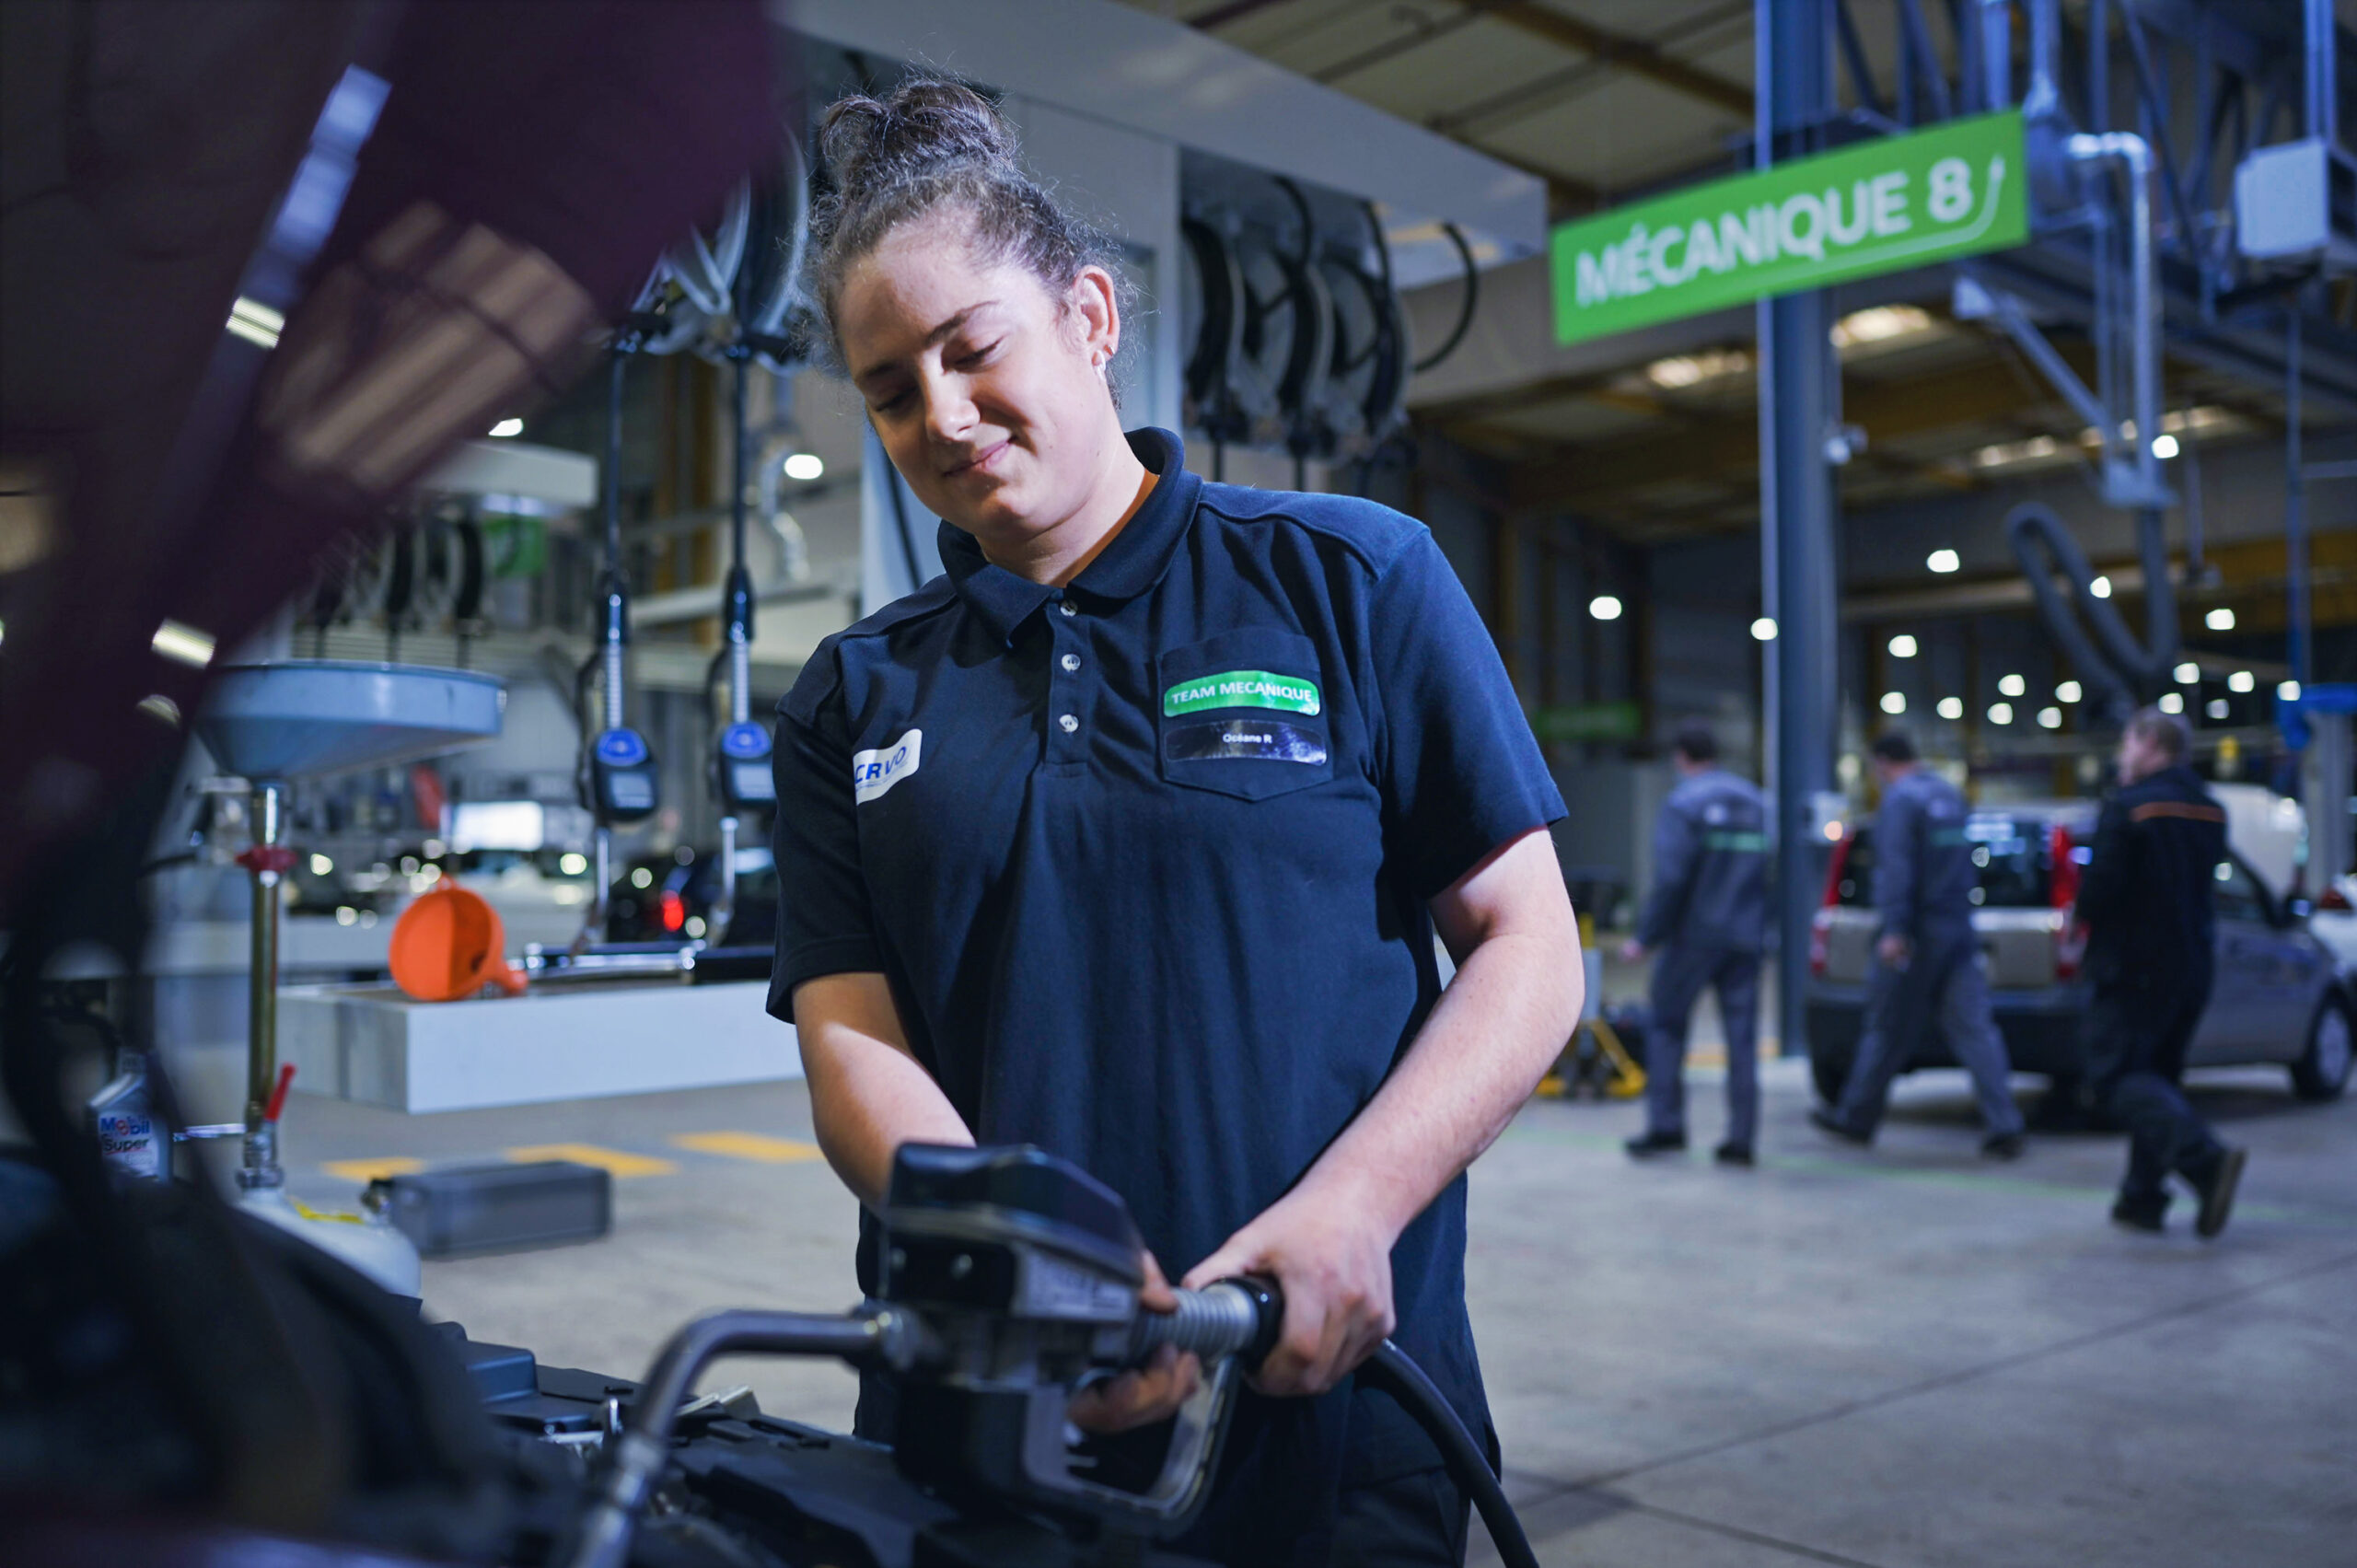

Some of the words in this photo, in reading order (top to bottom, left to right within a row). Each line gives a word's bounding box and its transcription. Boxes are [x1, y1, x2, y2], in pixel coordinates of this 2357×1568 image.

[1575, 170, 1911, 308] MÉCANIQUE
[1928, 157, 1974, 223] 8
[1171, 685, 1215, 704] TEAM
[1220, 681, 1312, 702] MECANIQUE
[854, 746, 906, 784] CRVO
[100, 1117, 150, 1135] Mobil
[103, 1139, 149, 1153] Super
